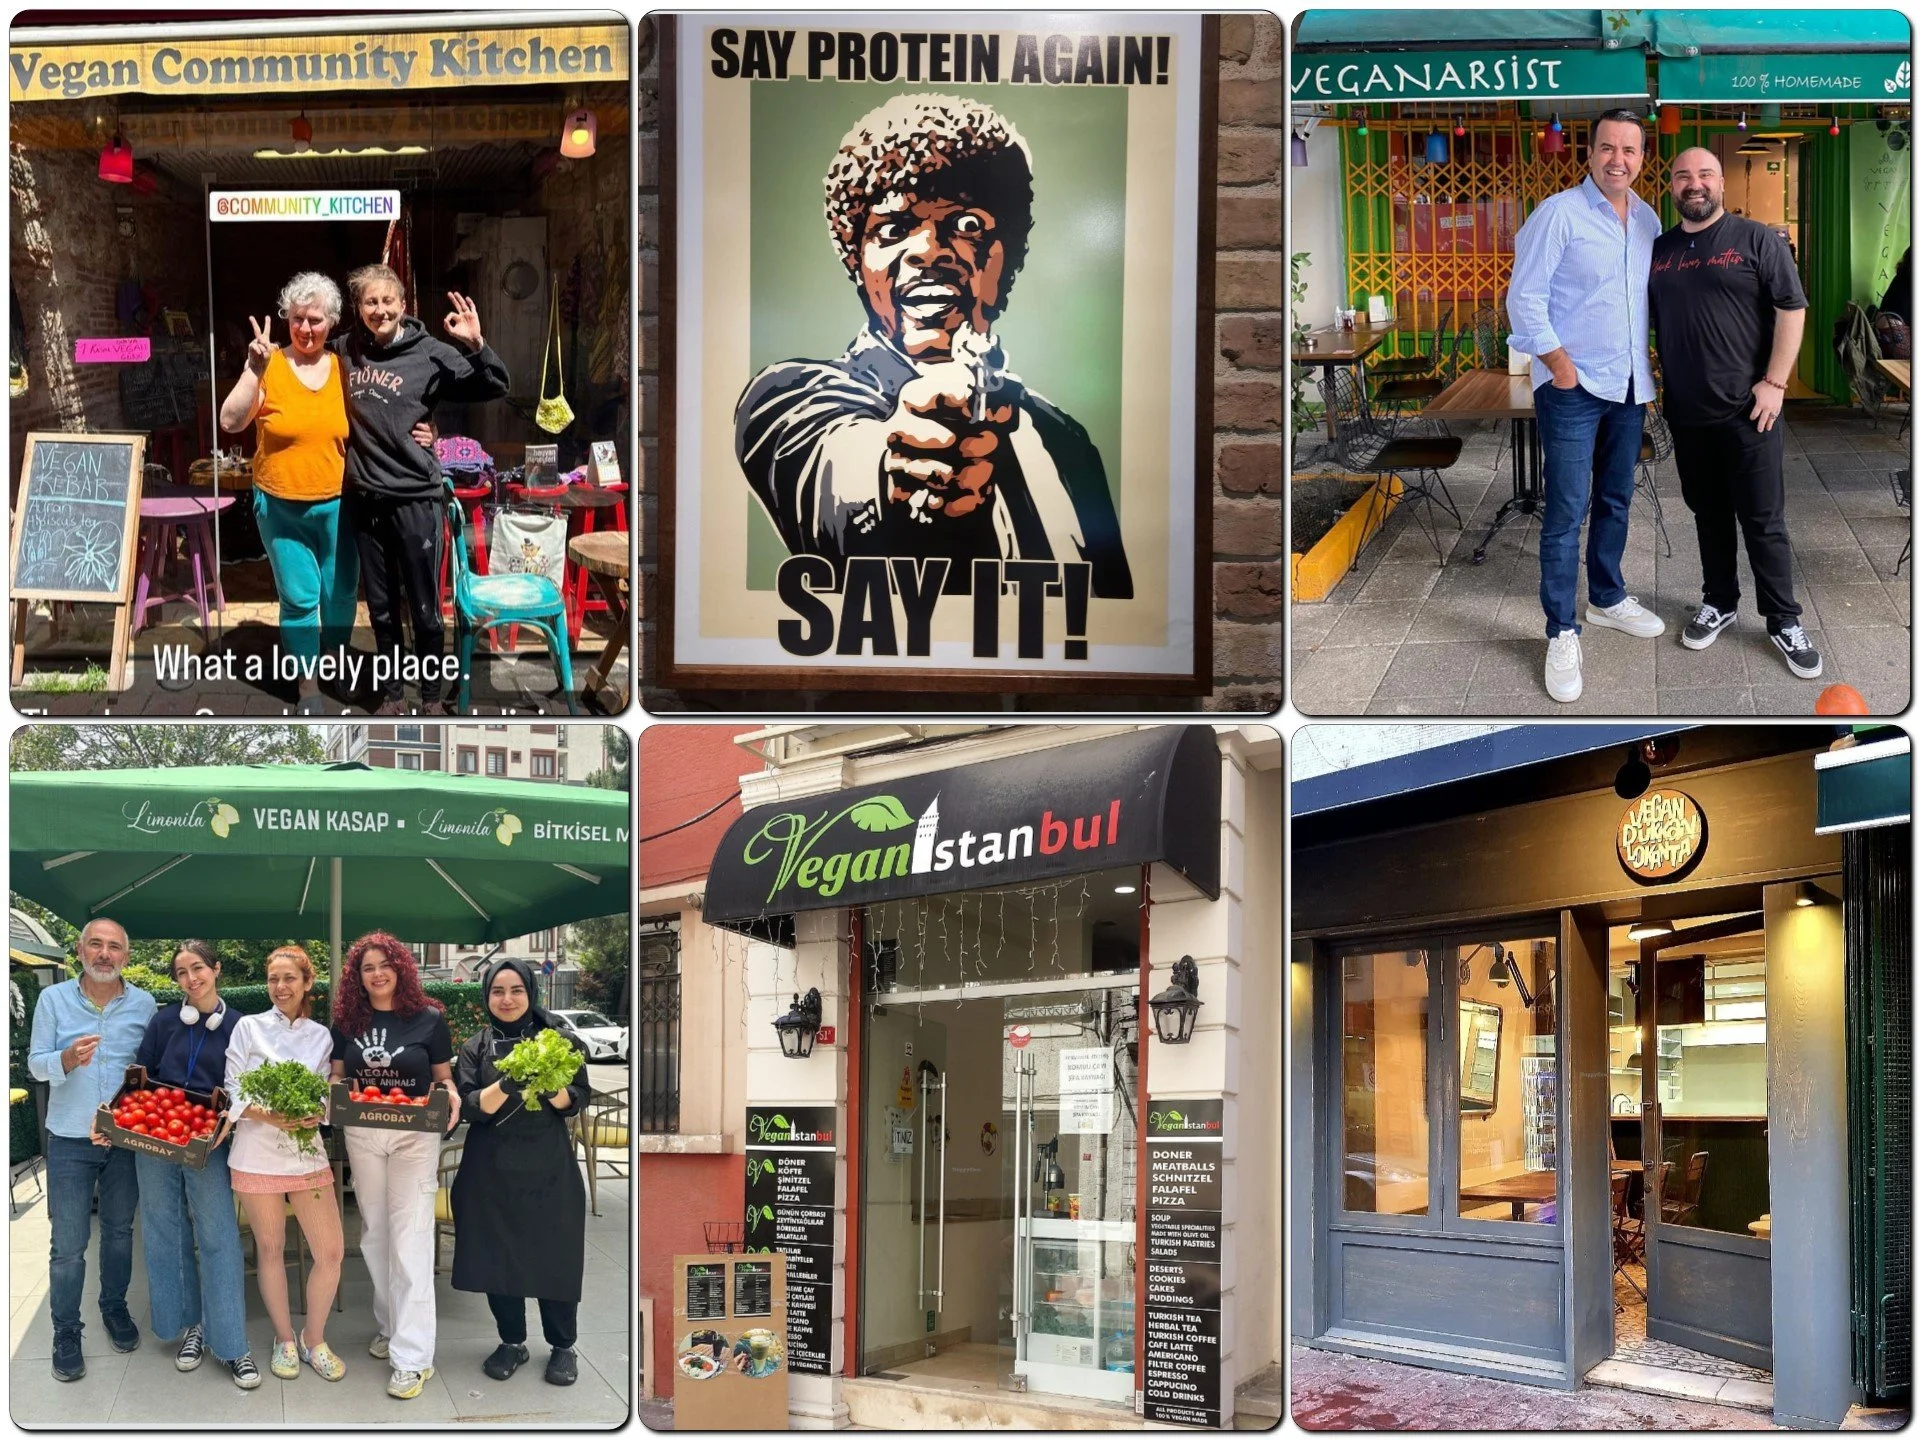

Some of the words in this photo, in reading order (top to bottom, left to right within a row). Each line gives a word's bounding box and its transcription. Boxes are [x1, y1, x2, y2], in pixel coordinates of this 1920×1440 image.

[711, 28, 796, 79] SAY
[807, 31, 1000, 82] PROTEIN
[1010, 34, 1171, 85] AGAIN!
[10, 52, 140, 99] Vegan
[152, 41, 418, 87] Community
[429, 36, 613, 77] Kitchen
[1732, 75, 1756, 88] 100
[1774, 75, 1862, 89] HOMEMADE
[38, 446, 102, 476] VEGAN
[36, 471, 109, 501] KEBAB
[777, 555, 951, 657] SAY
[972, 559, 1092, 660] IT!
[1629, 794, 1685, 828] VEGAN
[253, 807, 320, 830] VEGAN
[326, 810, 389, 832] KASAP
[534, 820, 611, 842] BİTKİSEL
[356, 1069, 399, 1077] VEGAN
[380, 1078, 416, 1087] ANIMALS
[360, 1111, 413, 1123] AGROBAY
[123, 1137, 174, 1156] AGROBAY
[1152, 1151, 1193, 1160] DONER
[778, 1157, 806, 1166] DÖNER
[778, 1166, 803, 1175] KÖFTE
[1152, 1162, 1216, 1171] MEATBALLS
[1152, 1174, 1213, 1183] SCHNITZEL
[777, 1185, 808, 1194] FALAFEL
[1152, 1185, 1198, 1194] FALAFEL
[777, 1193, 800, 1202] PİZZA
[1152, 1196, 1186, 1205] PIZZA
[1151, 1214, 1171, 1222] SOUP
[776, 1224, 806, 1233] BÖREKLER
[776, 1233, 808, 1241] SALATALAR
[1151, 1238, 1181, 1247] TURKISH
[1182, 1239, 1216, 1248] PASTRIES
[1150, 1247, 1178, 1256] SALADS
[1149, 1265, 1184, 1274] DESERTS
[1149, 1275, 1186, 1284] COOKIES
[1148, 1284, 1175, 1293] CAKES
[1149, 1294, 1194, 1304] PUDDINGS
[1148, 1312, 1184, 1321] TURKISH
[1186, 1314, 1202, 1323] TEA
[793, 1325, 813, 1333] KAHVE
[1148, 1321, 1180, 1331] HERBAL
[1182, 1324, 1198, 1332] TEA
[1148, 1331, 1184, 1341] TURKISH
[1186, 1334, 1217, 1344] COFFEE
[1148, 1341, 1168, 1349] CAFE
[1170, 1342, 1194, 1351] LATTE
[1148, 1350, 1199, 1362] AMERICANO
[1148, 1361, 1173, 1369] FILTER
[1175, 1363, 1206, 1373] COFFEE
[1148, 1370, 1188, 1380] ESPRESSO
[1148, 1379, 1198, 1391] CAPPUCINO
[1148, 1389, 1170, 1398] COLD
[1172, 1391, 1205, 1402] DRINKS
[1166, 1408, 1195, 1416] PRODUCTS
[1171, 1414, 1191, 1422] VEGAN
